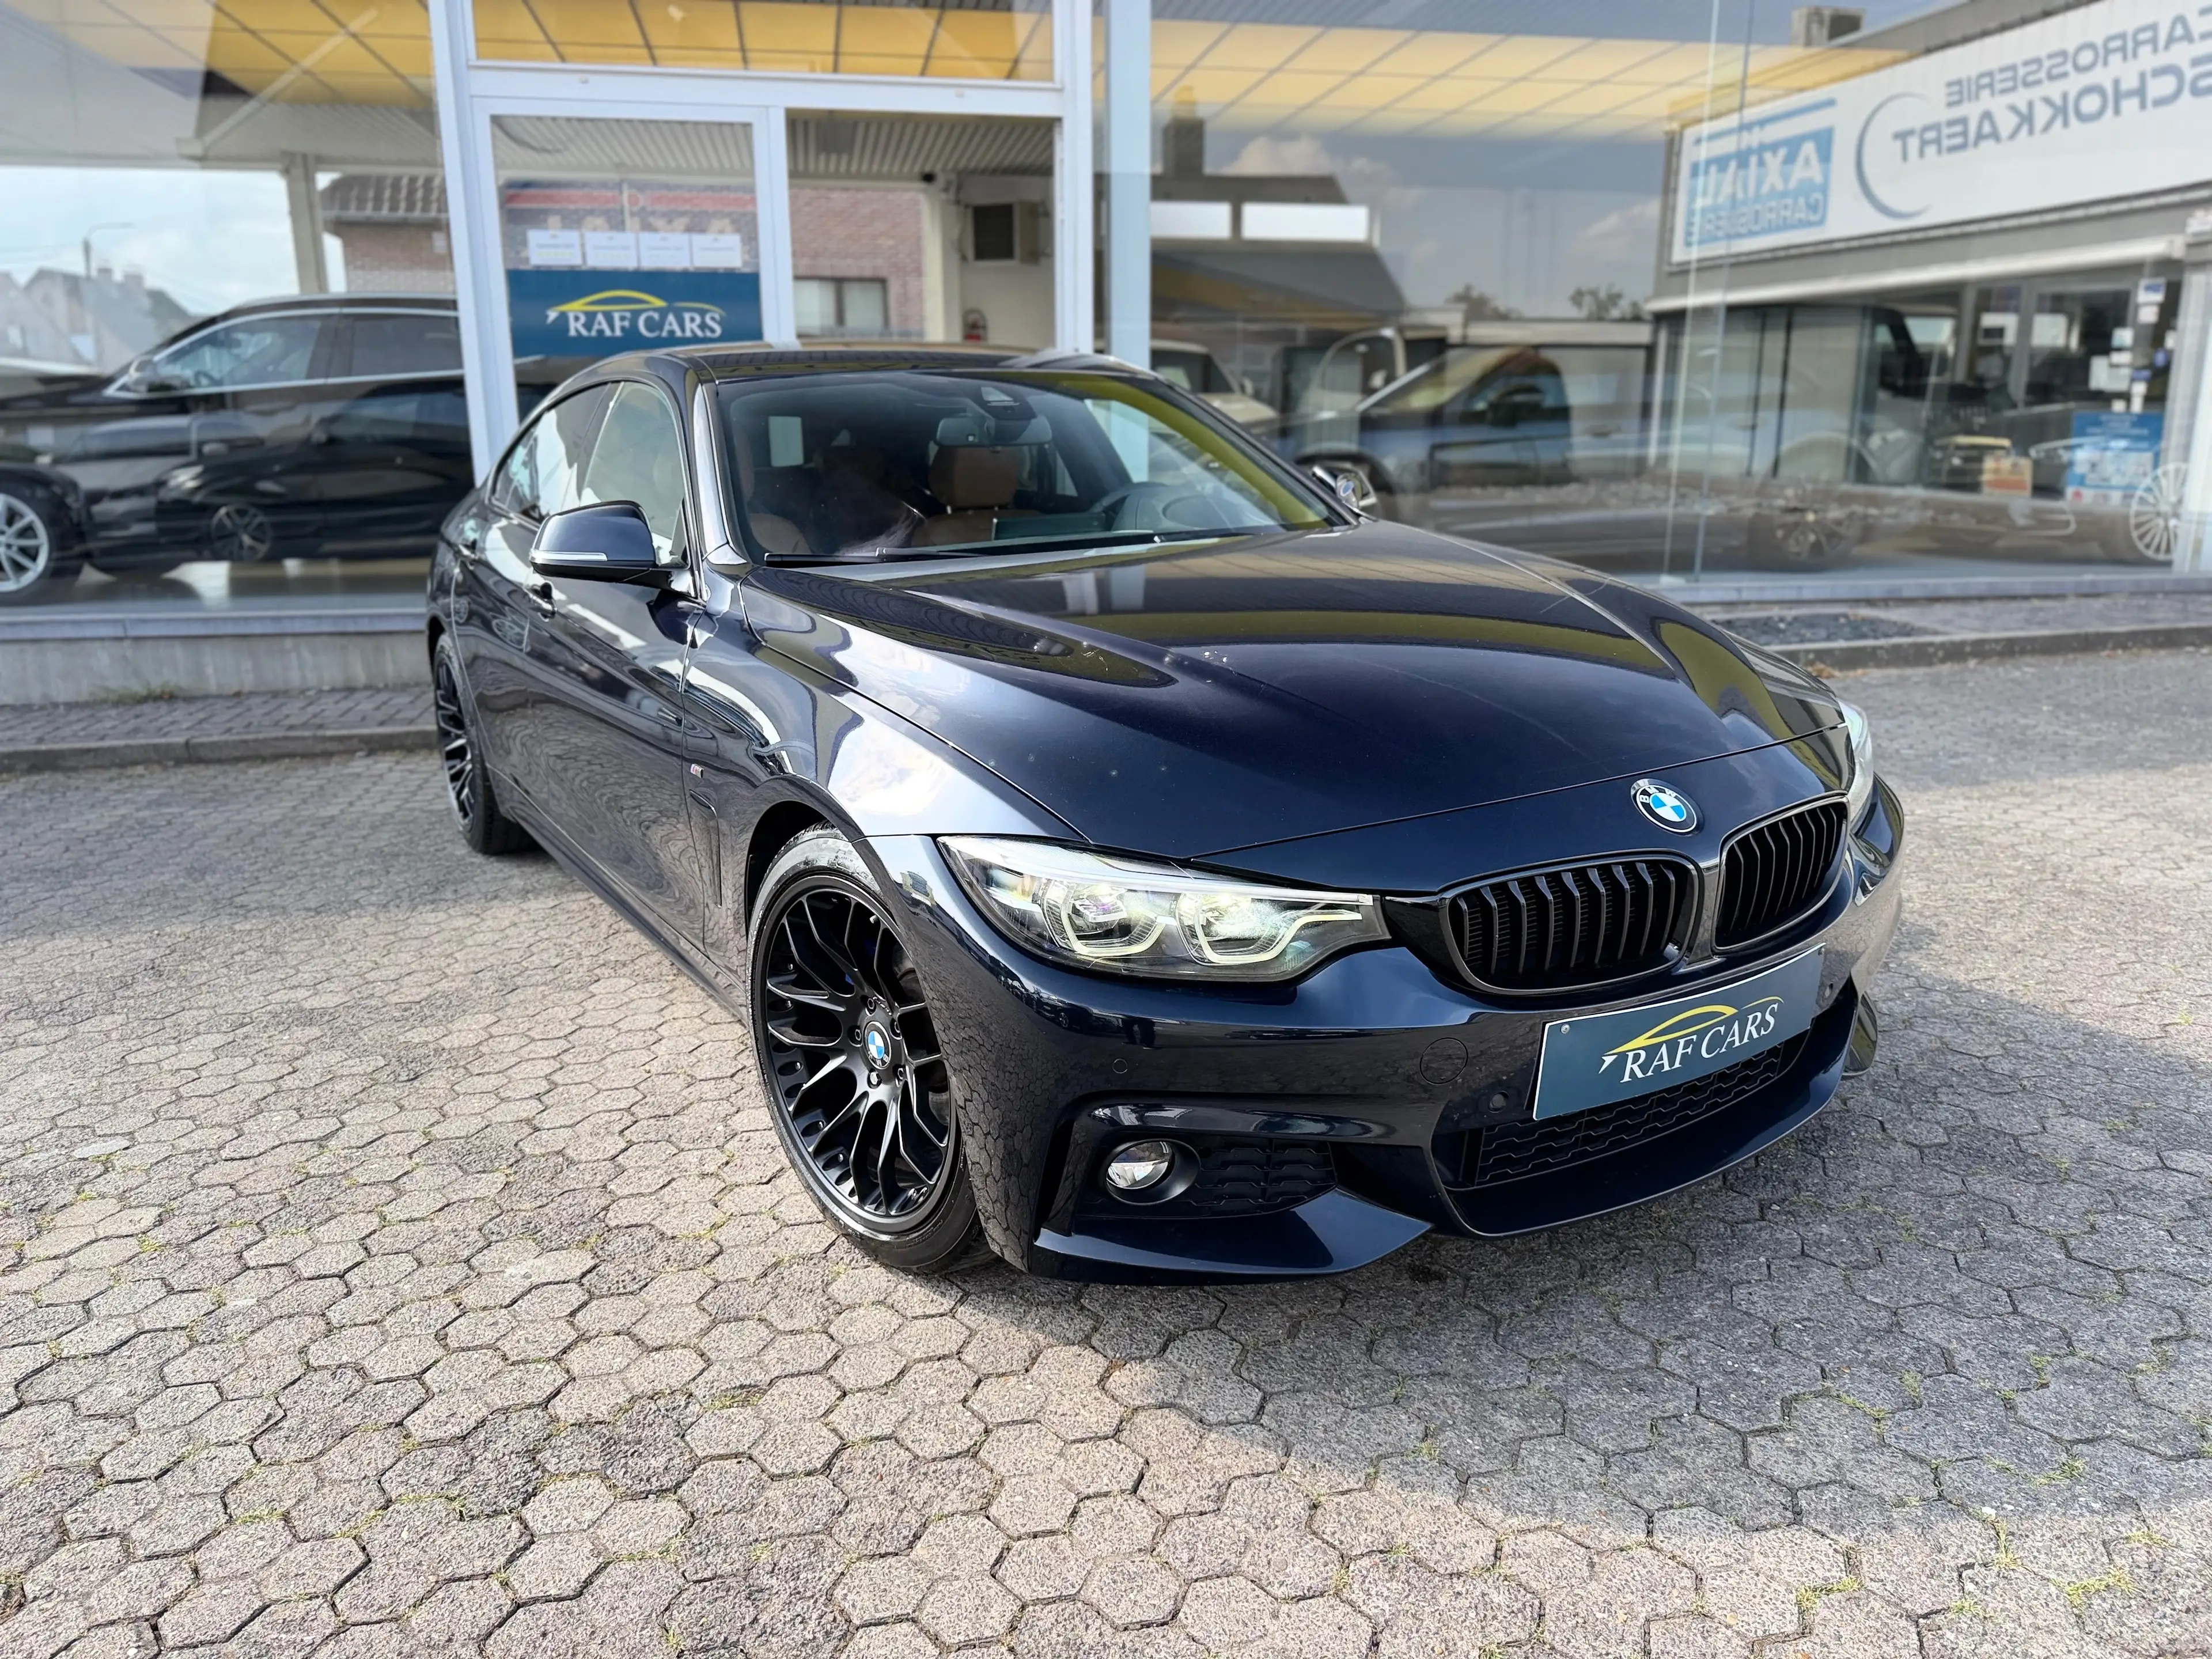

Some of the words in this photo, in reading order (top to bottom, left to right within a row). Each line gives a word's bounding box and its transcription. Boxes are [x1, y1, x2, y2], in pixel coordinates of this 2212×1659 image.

[567, 310, 631, 337] RAF
[637, 309, 722, 338] CARS
[1639, 786, 1676, 804] BMW
[1620, 1035, 1698, 1083] RAF
[1700, 1002, 1779, 1059] CARS
